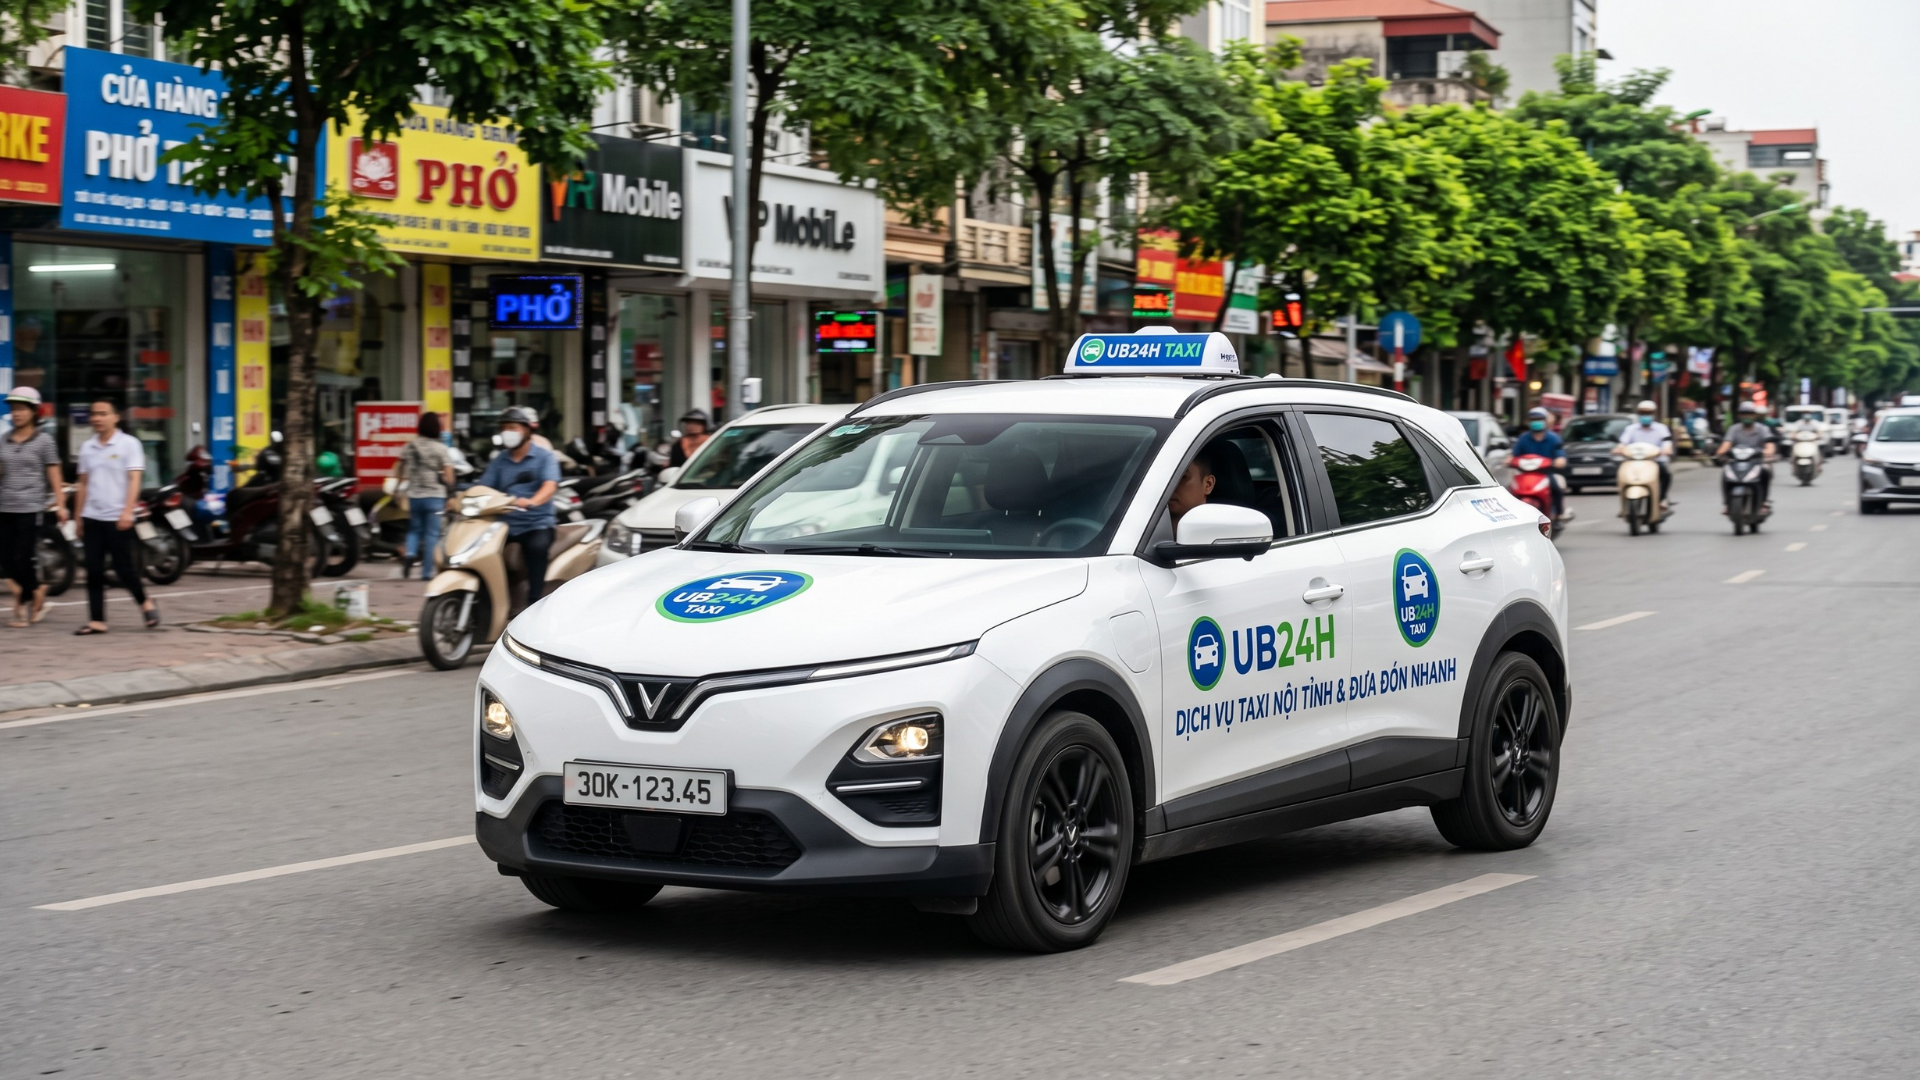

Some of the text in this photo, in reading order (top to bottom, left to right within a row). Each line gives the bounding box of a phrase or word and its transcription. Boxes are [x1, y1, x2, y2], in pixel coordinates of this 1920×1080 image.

[101, 65, 150, 108] CỬA
[155, 76, 217, 118] HÀNG
[85, 120, 159, 182] PHỞ
[416, 150, 519, 211] PHỞ
[602, 173, 682, 220] Mobile
[496, 284, 571, 322] PHỞ
[1107, 343, 1202, 358] UB24H TAXI
[672, 591, 767, 605] UB24H
[684, 604, 726, 615] TAXI
[1400, 603, 1435, 622] UB24H
[1232, 614, 1335, 675] UB24H
[1409, 622, 1426, 635] TAXI
[1176, 657, 1457, 741] DỊCH VỤ TAXI NỘI TỈNH & ĐƯA ĐÓN NHANH
[577, 771, 711, 805] 30K-123.45
